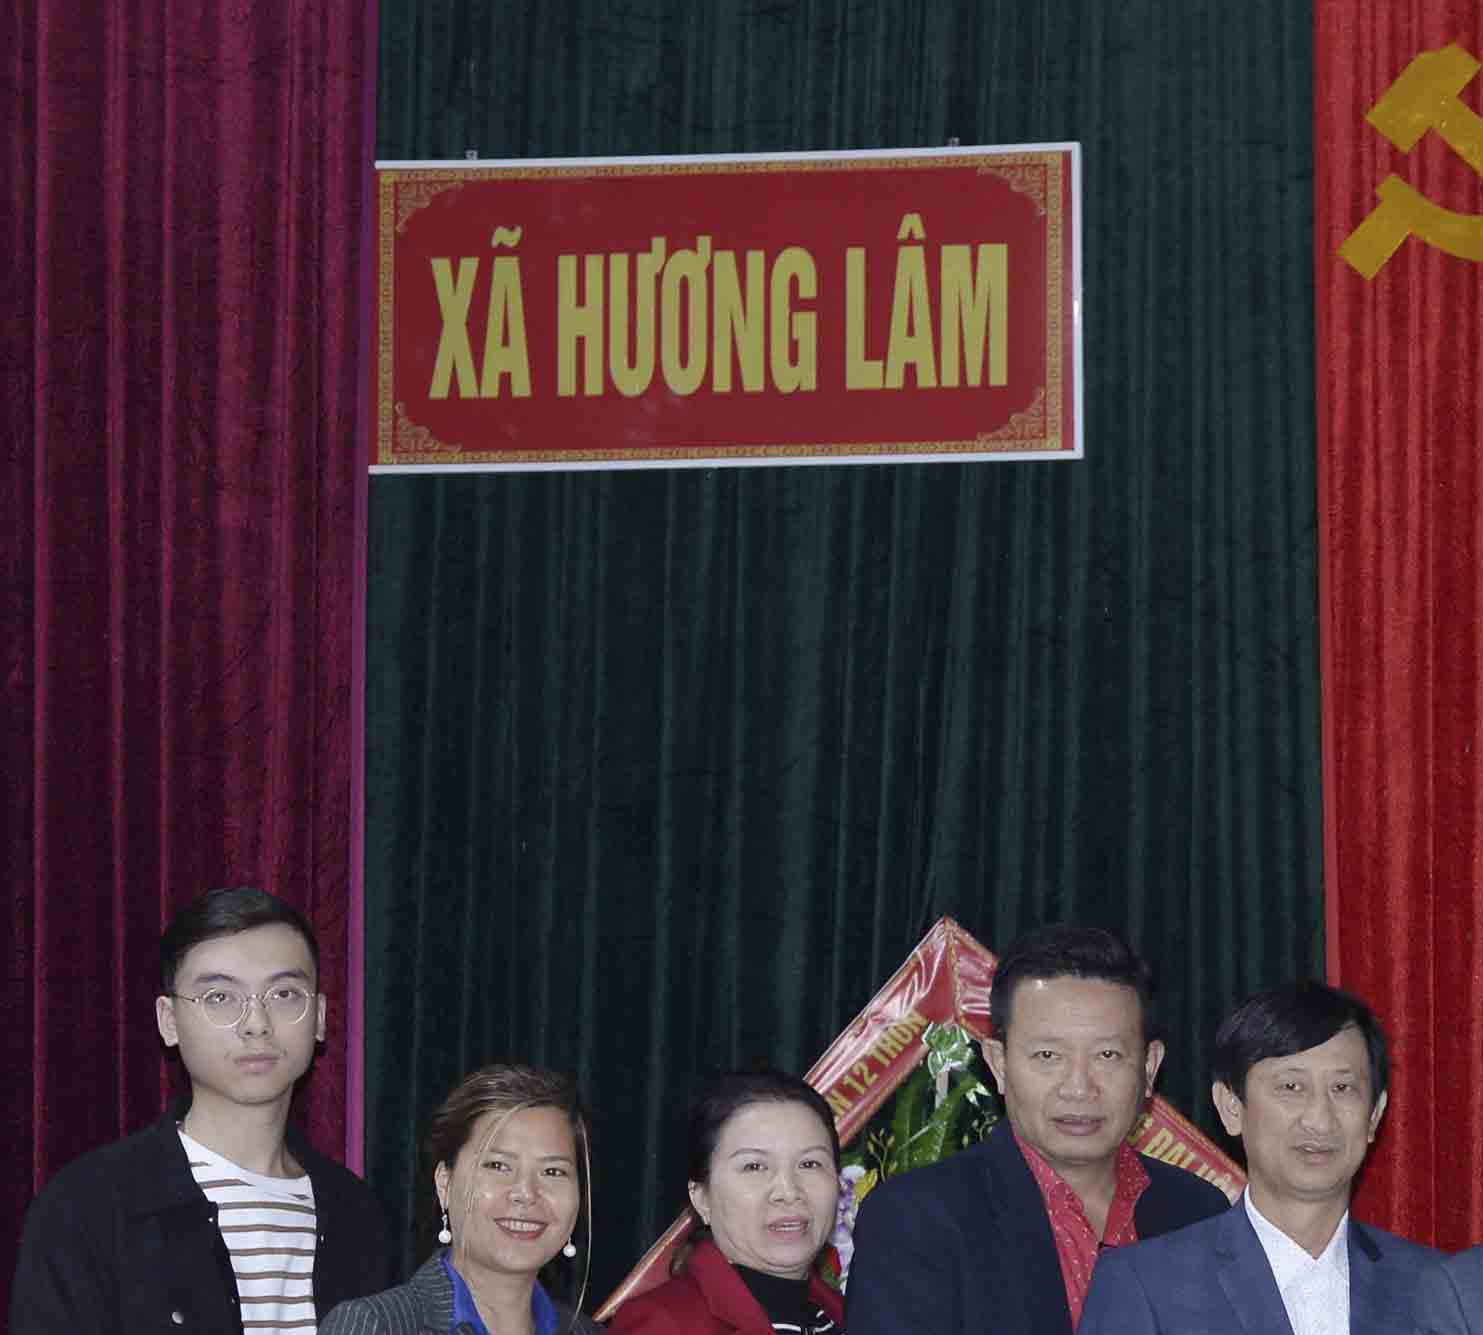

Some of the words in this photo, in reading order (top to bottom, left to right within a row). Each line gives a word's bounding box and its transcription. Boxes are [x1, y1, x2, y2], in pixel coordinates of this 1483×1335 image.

[429, 225, 531, 400] XÃ
[557, 235, 817, 398] HƯƠNG
[845, 213, 1009, 390] LÂM
[844, 1060, 878, 1095] 12
